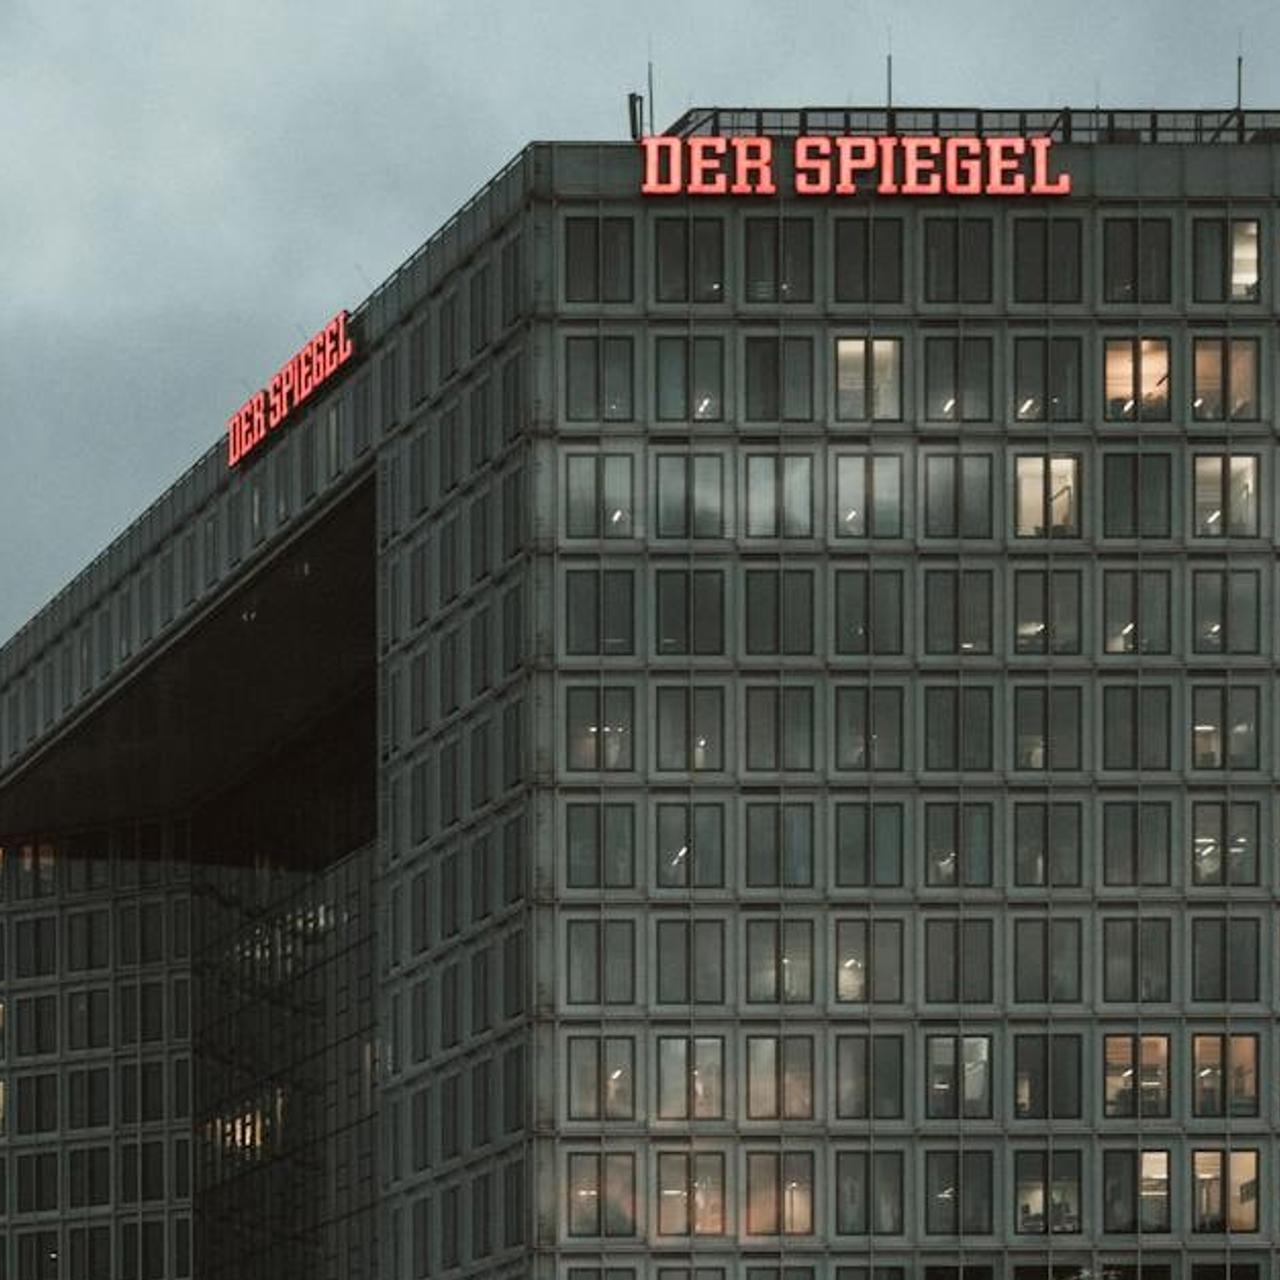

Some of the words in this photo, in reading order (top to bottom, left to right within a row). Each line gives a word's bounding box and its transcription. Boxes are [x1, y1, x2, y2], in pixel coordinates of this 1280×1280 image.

[639, 135, 777, 197] DER
[793, 135, 1073, 197] SPIEGEL
[227, 389, 268, 469] DER
[268, 310, 355, 429] SPIEGEL
